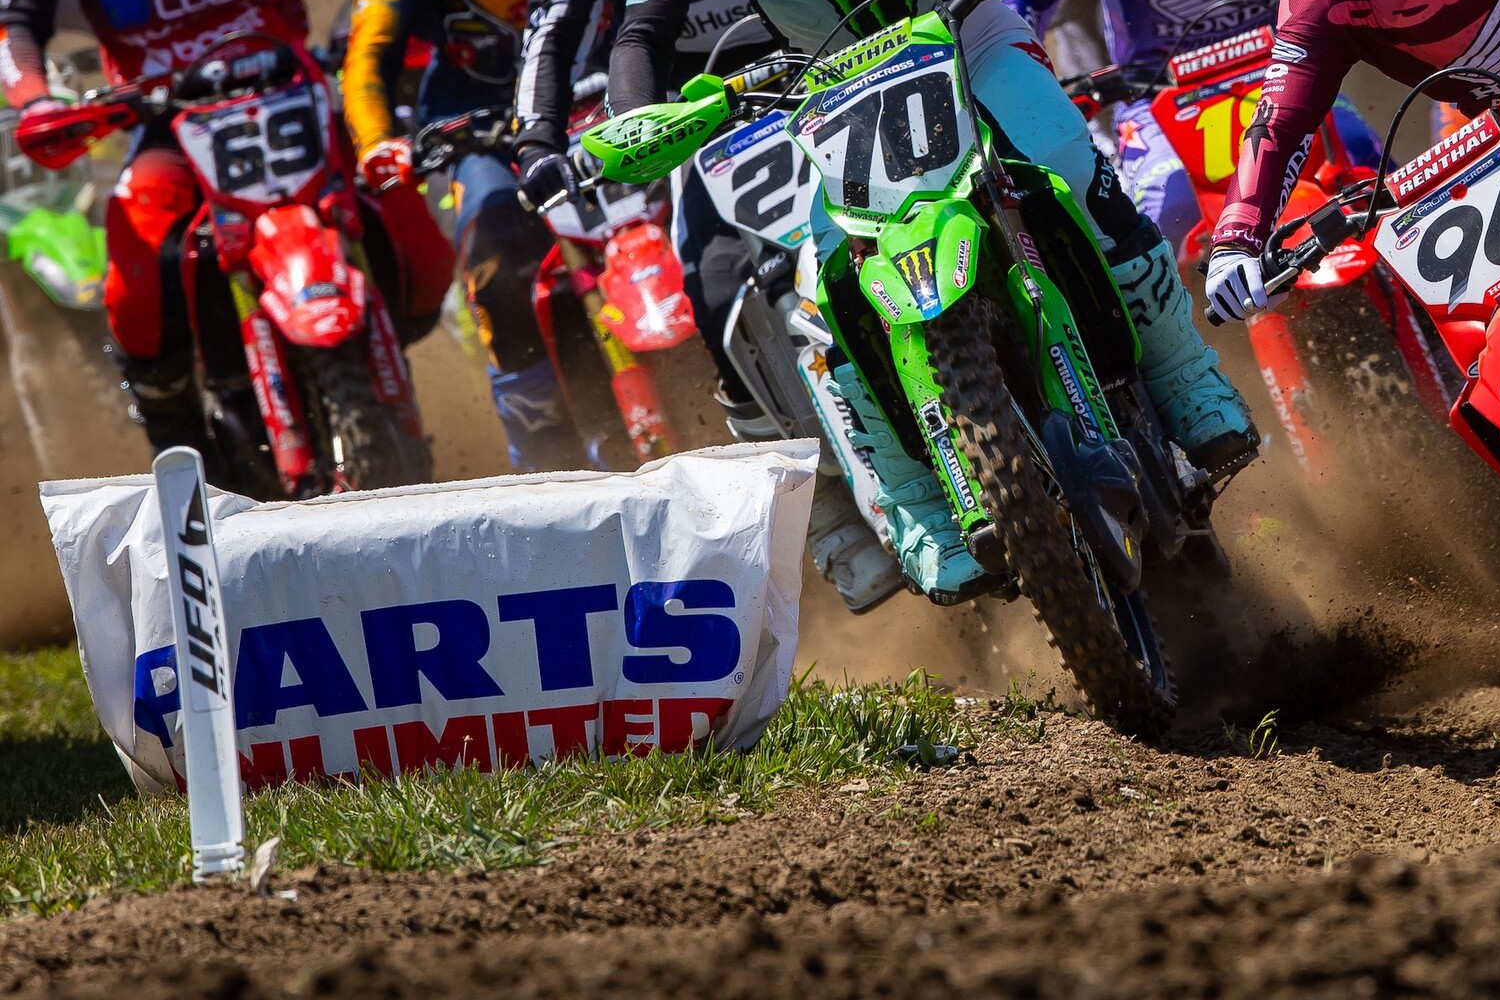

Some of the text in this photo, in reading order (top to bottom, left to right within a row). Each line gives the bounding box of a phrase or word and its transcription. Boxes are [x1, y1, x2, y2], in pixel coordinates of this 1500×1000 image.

[1178, 37, 1268, 77] RENTHAL
[211, 105, 322, 194] 69
[731, 139, 812, 232] 2
[813, 71, 960, 209] 70
[1391, 116, 1486, 184] RENTHAL
[1399, 129, 1493, 197] RENTHAL
[178, 552, 219, 696] UFO
[172, 697, 734, 794] NLIMITED
